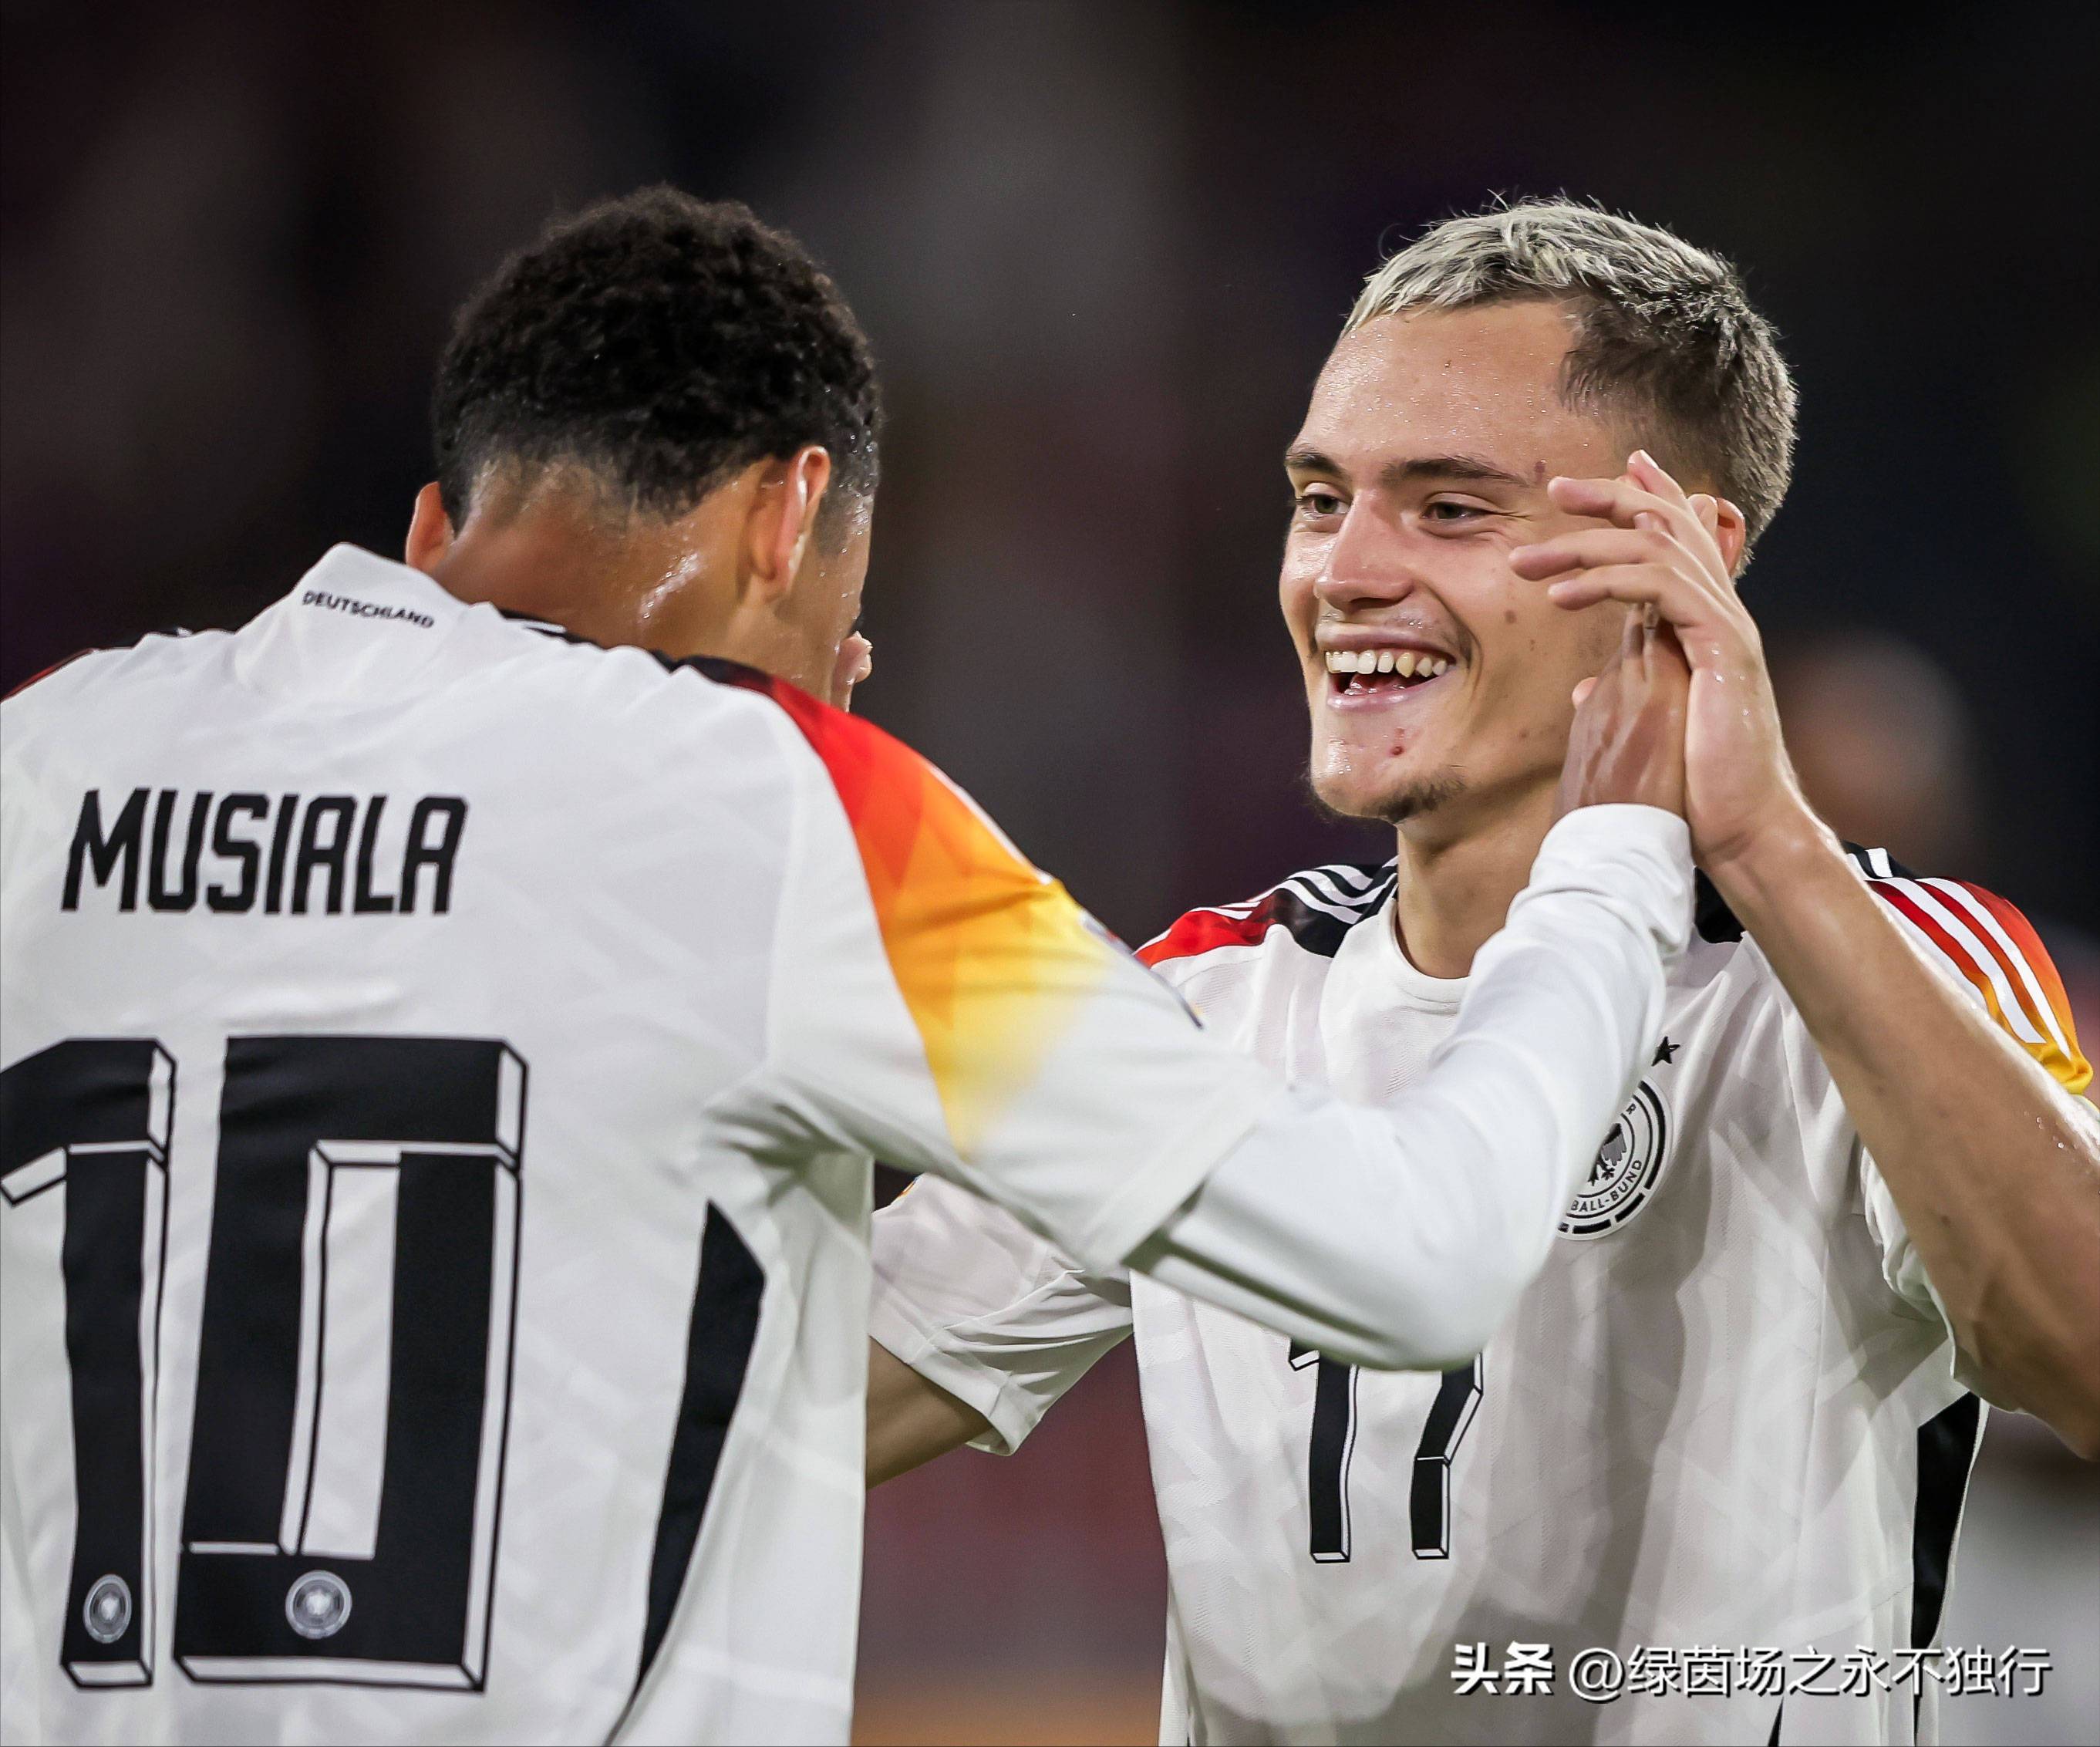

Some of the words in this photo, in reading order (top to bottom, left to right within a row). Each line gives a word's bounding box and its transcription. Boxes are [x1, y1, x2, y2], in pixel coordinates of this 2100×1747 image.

[302, 590, 435, 629] DEUTSCHLAND
[61, 787, 469, 916] MUSIALA
[1570, 1159, 1643, 1212] BALL-BUND
[0, 1036, 530, 1695] 10
